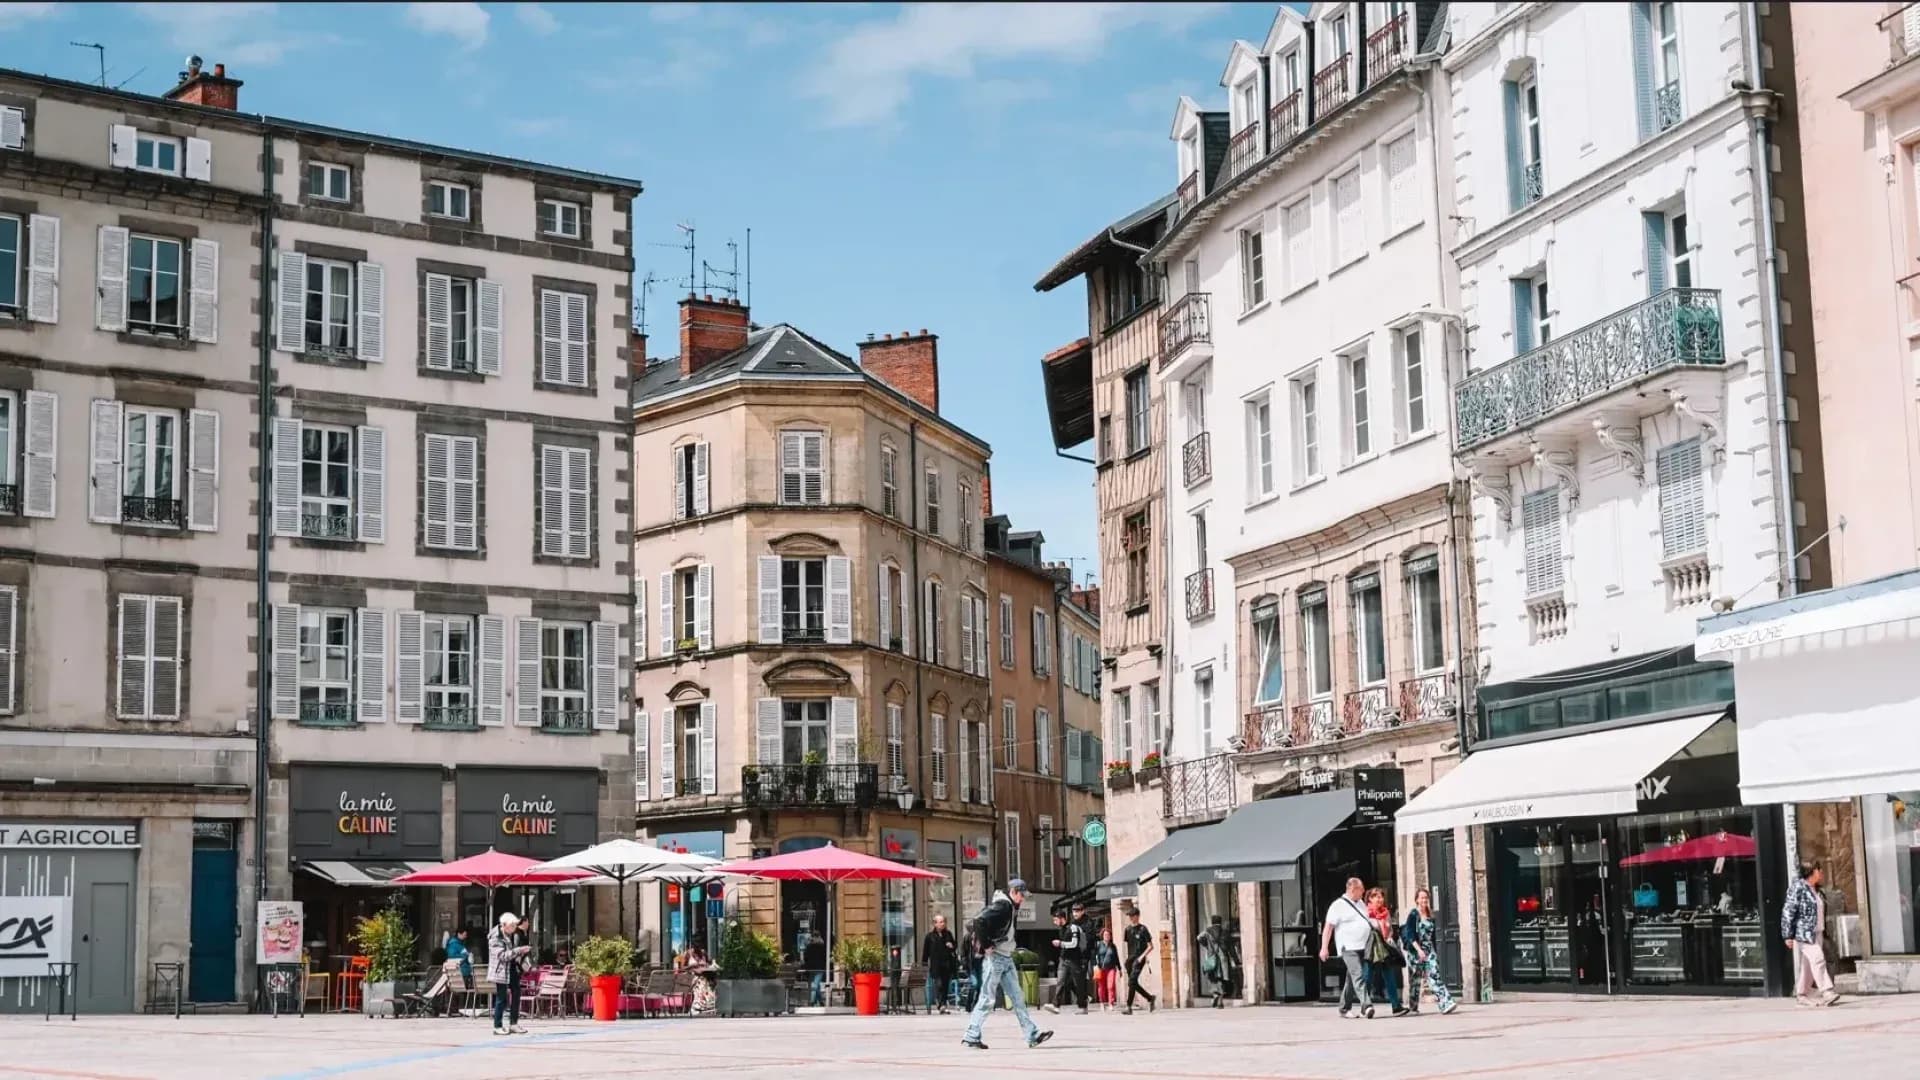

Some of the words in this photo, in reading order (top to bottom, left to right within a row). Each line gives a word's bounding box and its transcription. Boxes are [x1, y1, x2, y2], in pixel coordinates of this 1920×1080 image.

[340, 791, 359, 811] la
[360, 792, 396, 811] mie
[503, 793, 521, 813] la
[522, 795, 556, 813] mie
[1358, 789, 1403, 801] Philipparie
[339, 812, 397, 833] CÂLINE
[17, 829, 137, 845] AGRICOLE
